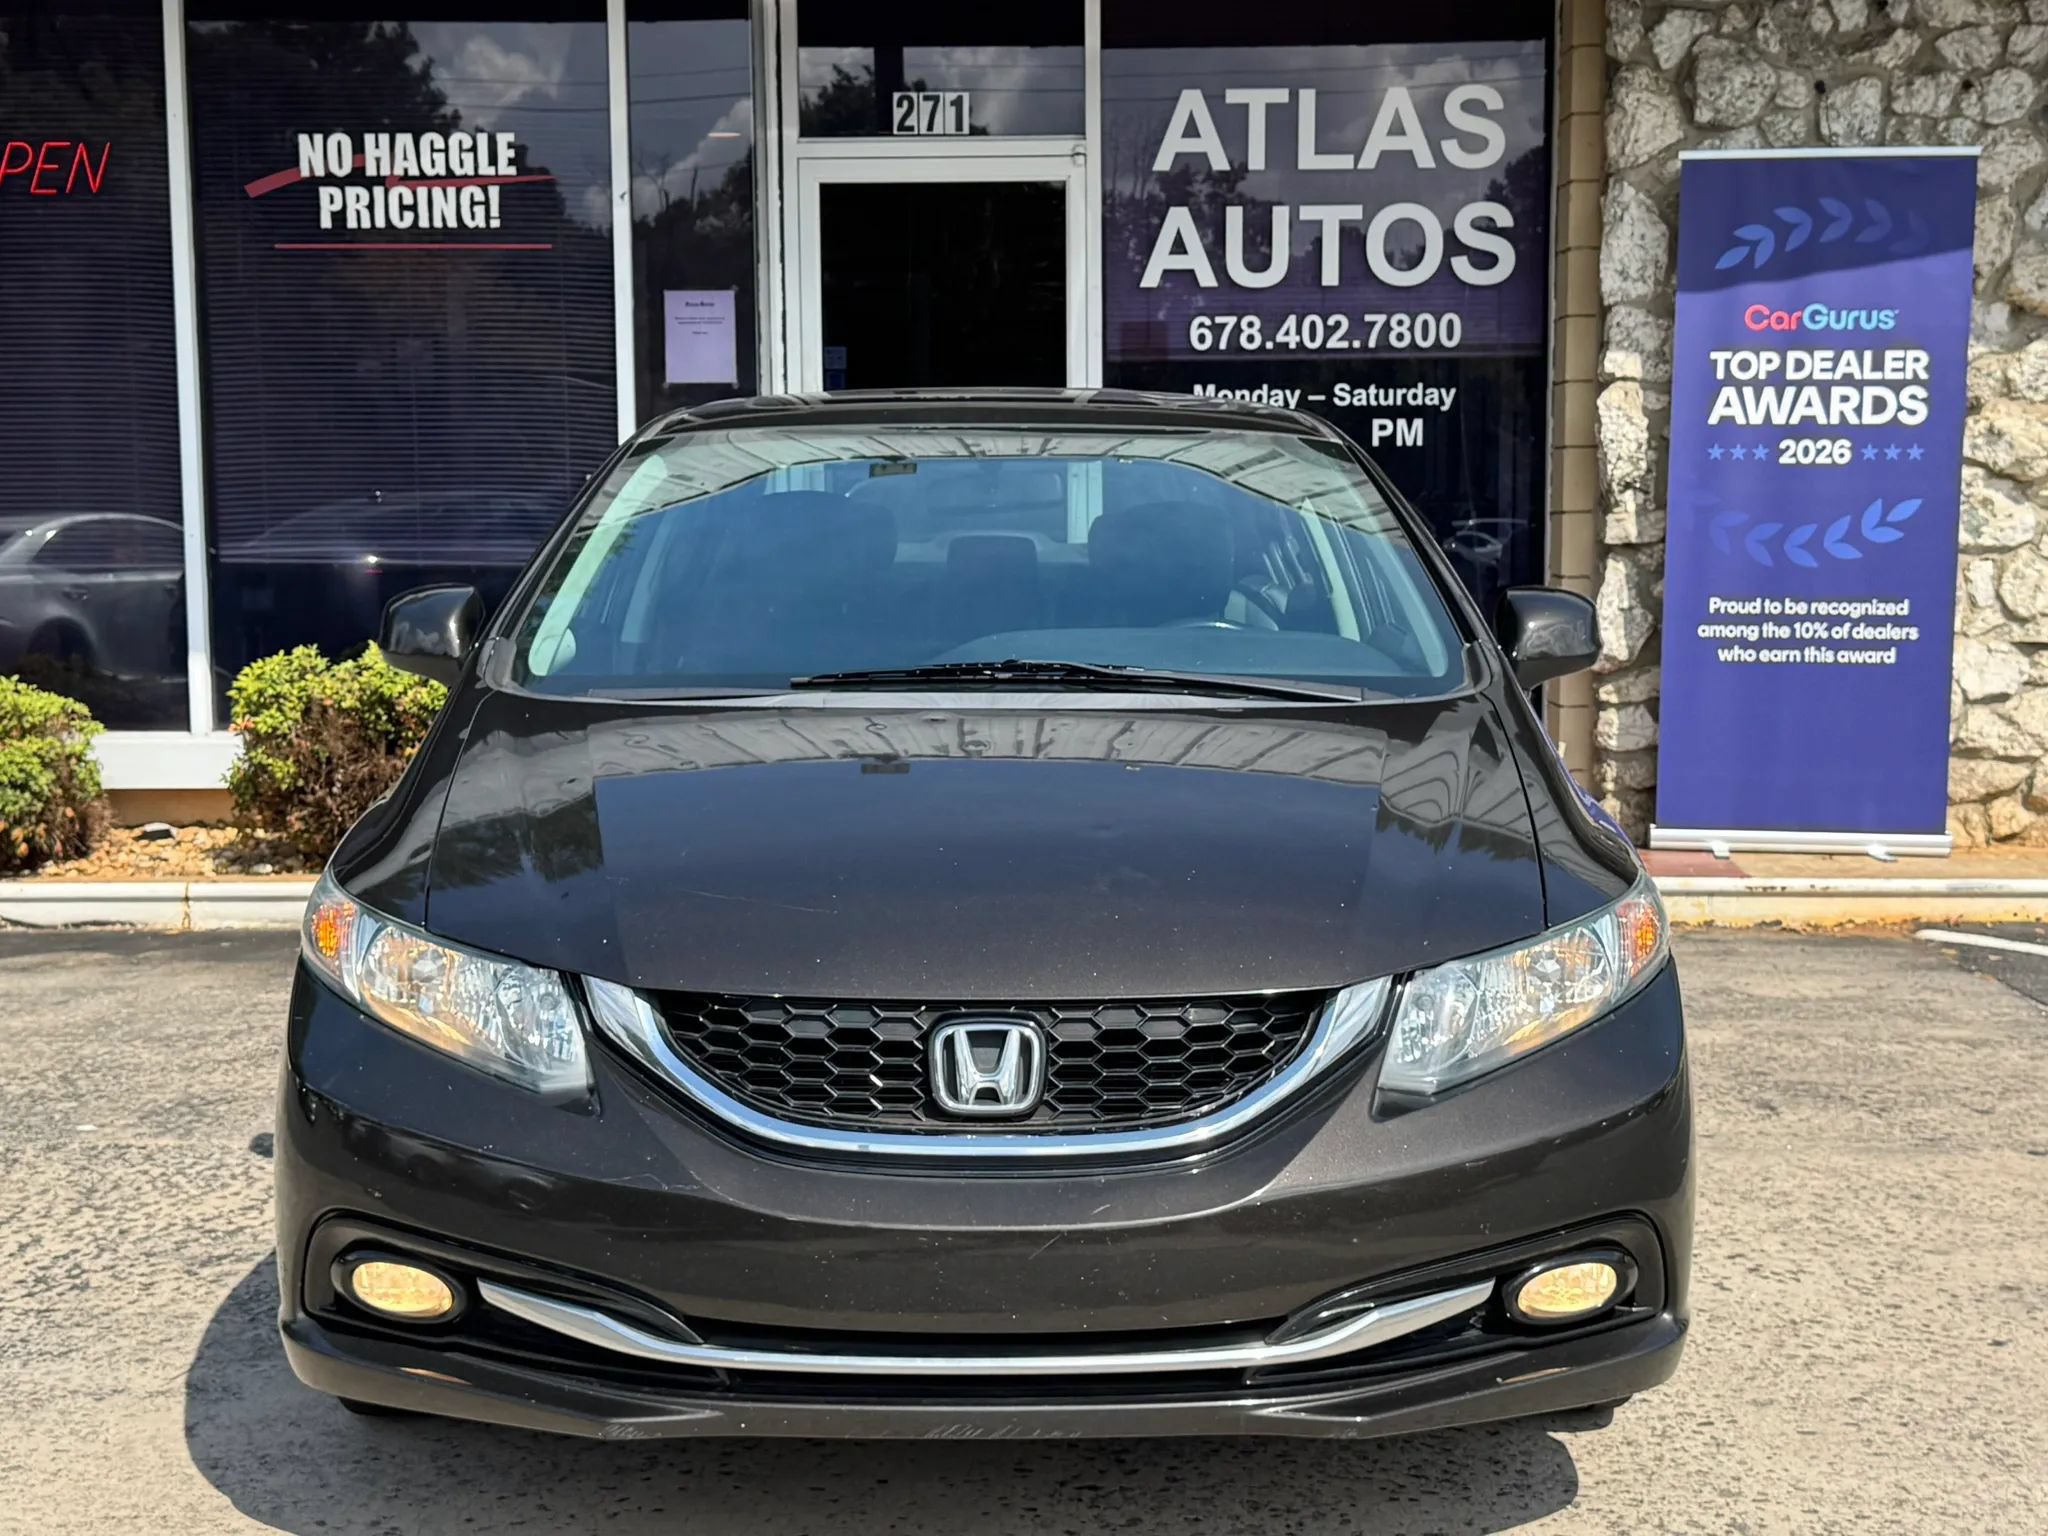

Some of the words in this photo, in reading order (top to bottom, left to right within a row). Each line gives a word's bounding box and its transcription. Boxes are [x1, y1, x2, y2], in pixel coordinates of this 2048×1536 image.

[896, 94, 964, 132] 271
[1152, 84, 1506, 171] ATLAS
[298, 132, 352, 177] NO
[364, 132, 517, 177] HAGGLE
[319, 185, 501, 229] PRICING!
[1139, 202, 1516, 288] AUTOS
[1189, 313, 1462, 350] 678.402.7800
[1744, 303, 1895, 331] CarGurus
[1709, 350, 1781, 380] TOP
[1785, 350, 1930, 380] DEALER
[1333, 383, 1456, 411] Saturday
[1707, 385, 1930, 426] AWARDS
[1372, 418, 1424, 447] PM
[1778, 438, 1853, 465] 2026
[1709, 597, 1762, 615] Proud
[1764, 598, 1782, 615] to
[1784, 598, 1808, 615] be
[1810, 598, 1910, 618] recognized
[1697, 624, 1760, 641] among
[1762, 622, 1792, 638] the
[1793, 621, 1829, 640] 10%
[1831, 622, 1851, 640] of
[1852, 622, 1920, 641] dealers
[1717, 645, 1757, 662] who
[1758, 649, 1801, 663] earn
[1803, 646, 1835, 663] this
[1836, 646, 1897, 664] award
